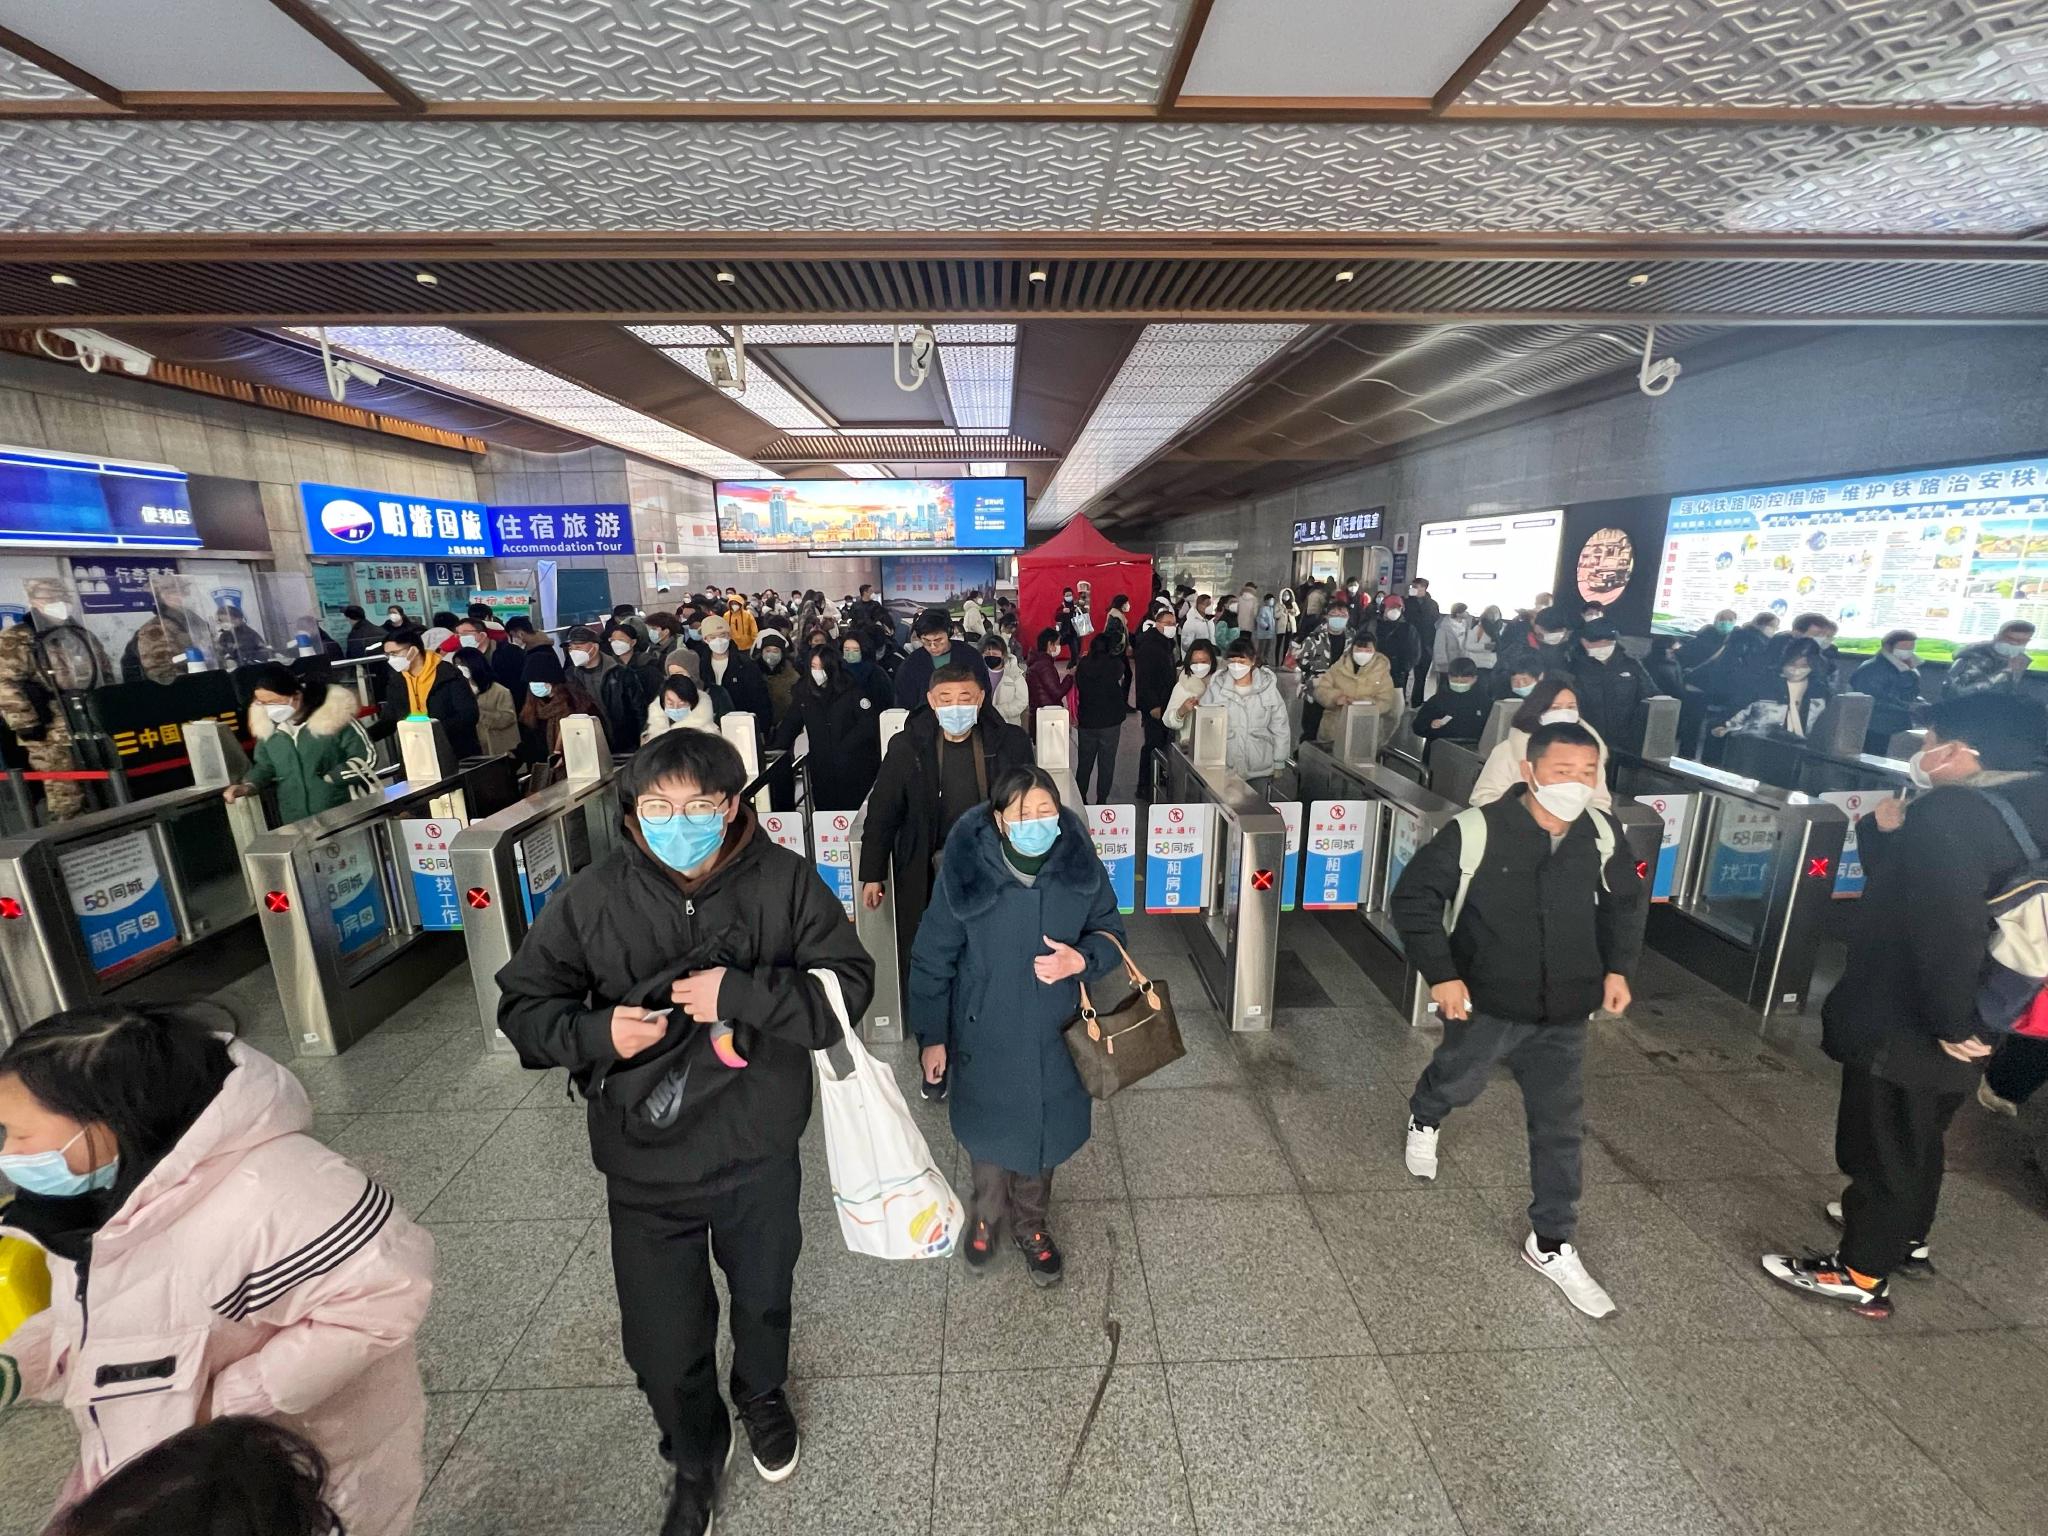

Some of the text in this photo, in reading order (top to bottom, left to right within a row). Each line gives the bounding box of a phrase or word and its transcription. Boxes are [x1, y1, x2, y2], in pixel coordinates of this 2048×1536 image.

[1680, 467, 2048, 515] 强化铁路防控措施 维护铁路治安秩
[141, 506, 191, 525] 便利店
[496, 512, 620, 540] 住宿旅游
[502, 541, 622, 553] Accommodation Tour
[1154, 826, 1196, 835] 禁止通行
[1316, 823, 1358, 832] 禁止通行
[415, 842, 447, 851] 禁止通
[1154, 841, 1195, 855] 58同城
[1315, 838, 1355, 851] 58同城
[418, 858, 452, 871] 58同
[823, 849, 850, 861] 58同
[1165, 860, 1181, 892] 租房
[1323, 857, 1341, 889] 租房
[83, 877, 145, 912] 58同城
[327, 872, 365, 902] 8同城
[434, 877, 460, 924] 找工作
[89, 919, 140, 955] 租房
